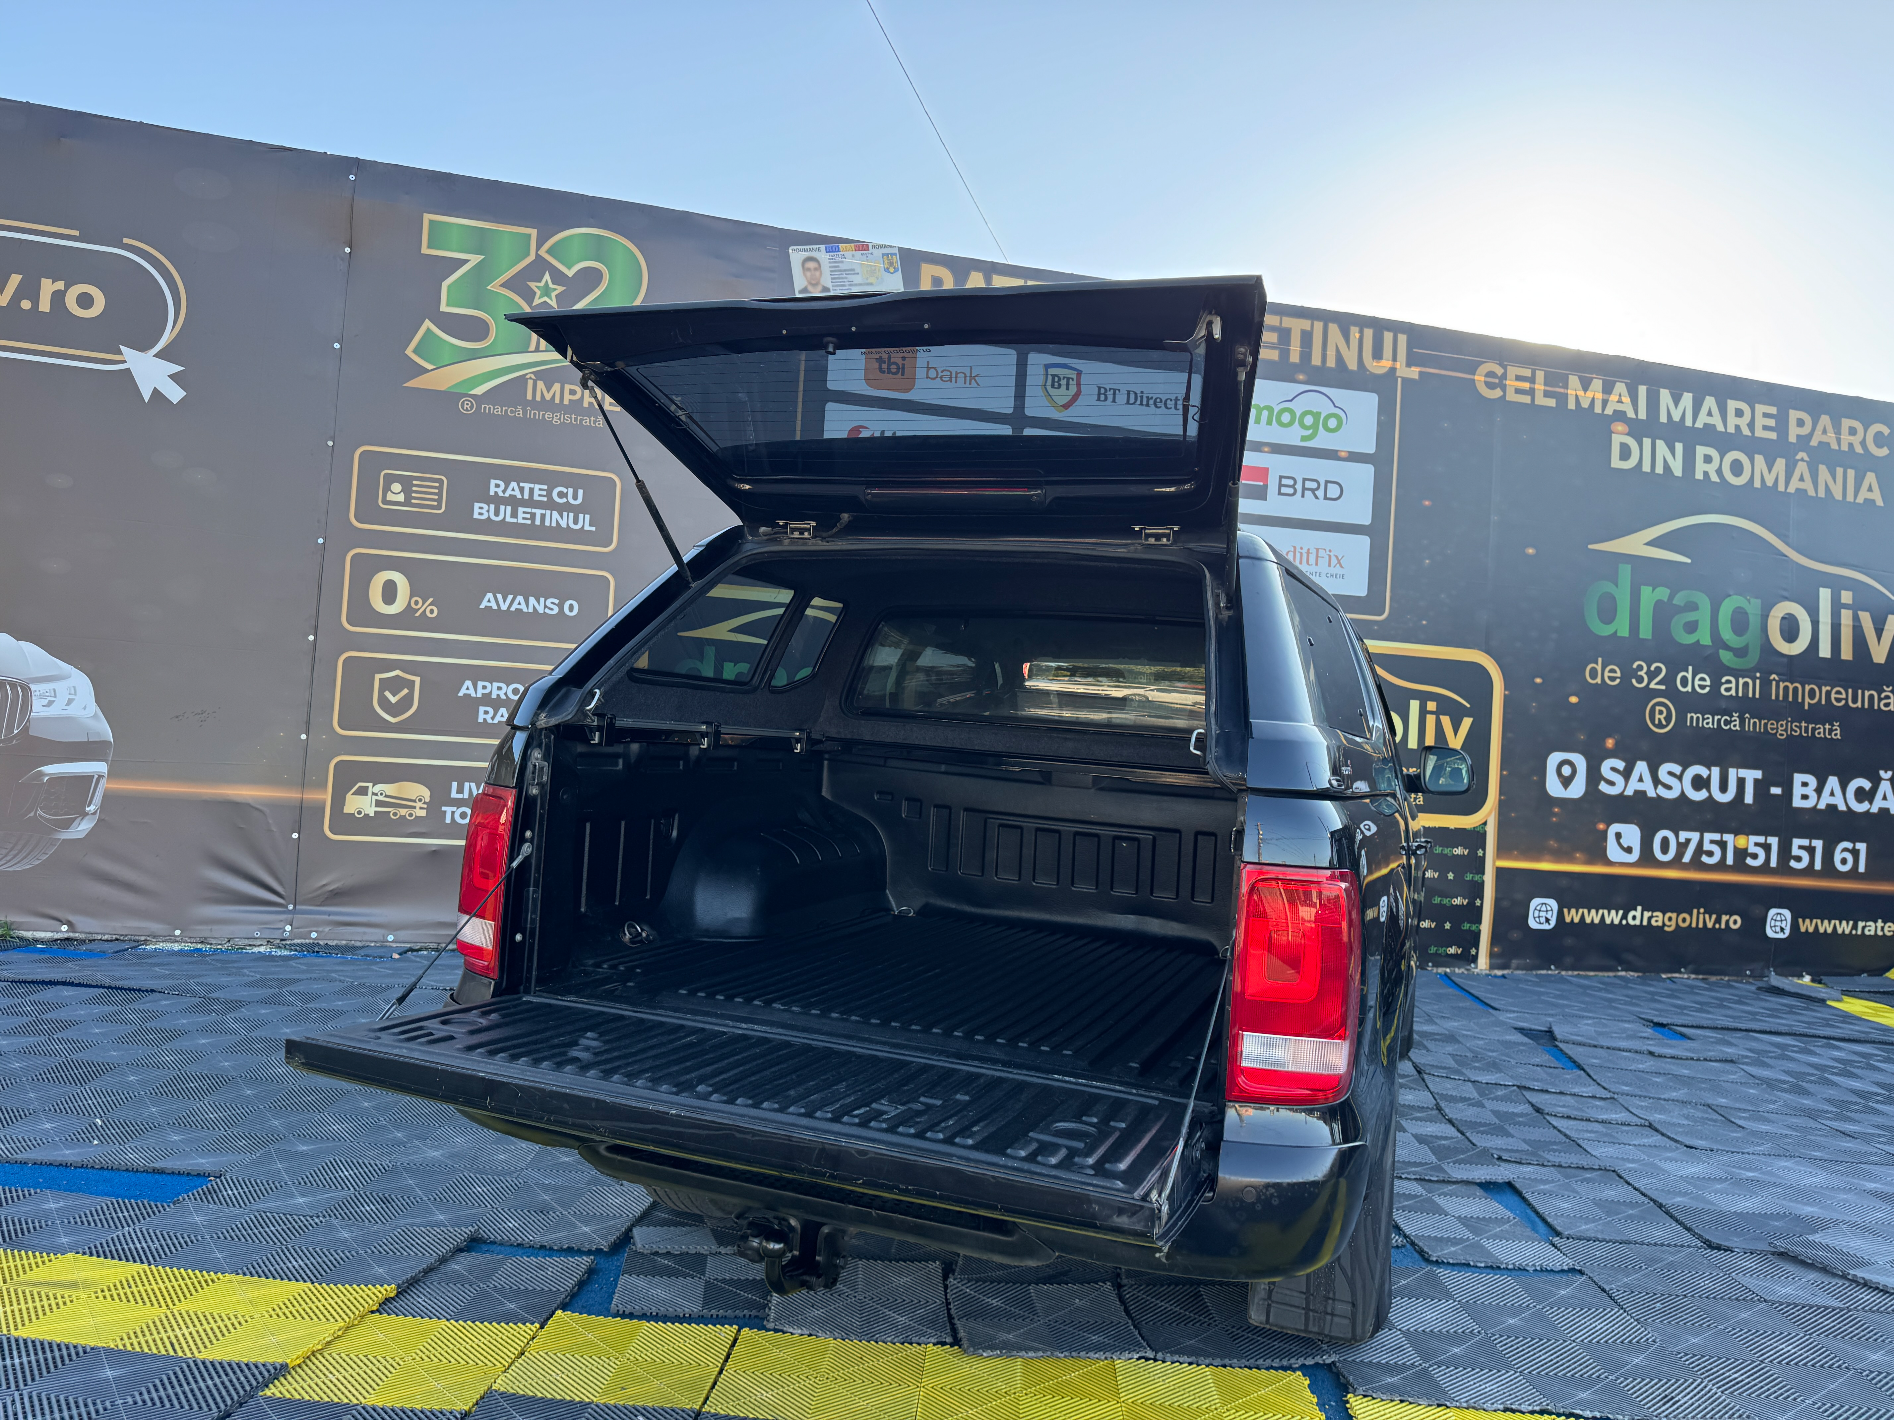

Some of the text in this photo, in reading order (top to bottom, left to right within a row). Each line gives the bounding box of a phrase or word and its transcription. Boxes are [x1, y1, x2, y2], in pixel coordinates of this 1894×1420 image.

[875, 354, 981, 387] tbi bank
[1050, 373, 1075, 391] BT
[1096, 385, 1181, 411] BT Direct
[1474, 362, 1892, 458] CEL MAI MARE PARC
[481, 401, 523, 418] marcă
[526, 406, 604, 428] înregistrată
[1251, 403, 1344, 443] mogo
[1610, 432, 1885, 508] DIN ROMÂNIA
[488, 478, 584, 506] RATE CU
[1277, 474, 1345, 502] BRD
[472, 502, 596, 532] BULETINUL
[1278, 545, 1345, 570] ditFix
[1305, 570, 1322, 579] NTE
[478, 592, 560, 616] AVANS
[1584, 657, 1894, 711] de 32 de ani împreună
[1686, 711, 1741, 732] marcă
[1744, 713, 1842, 740] înregistrată
[1598, 758, 1763, 804] SASCUT
[1433, 845, 1469, 856] dragoliv
[1652, 829, 1868, 873] 0751 51 51 61
[1432, 895, 1469, 906] dragoliv
[1562, 905, 1742, 932] www.dragoliv.ro
[1428, 945, 1463, 956] dragoliv
